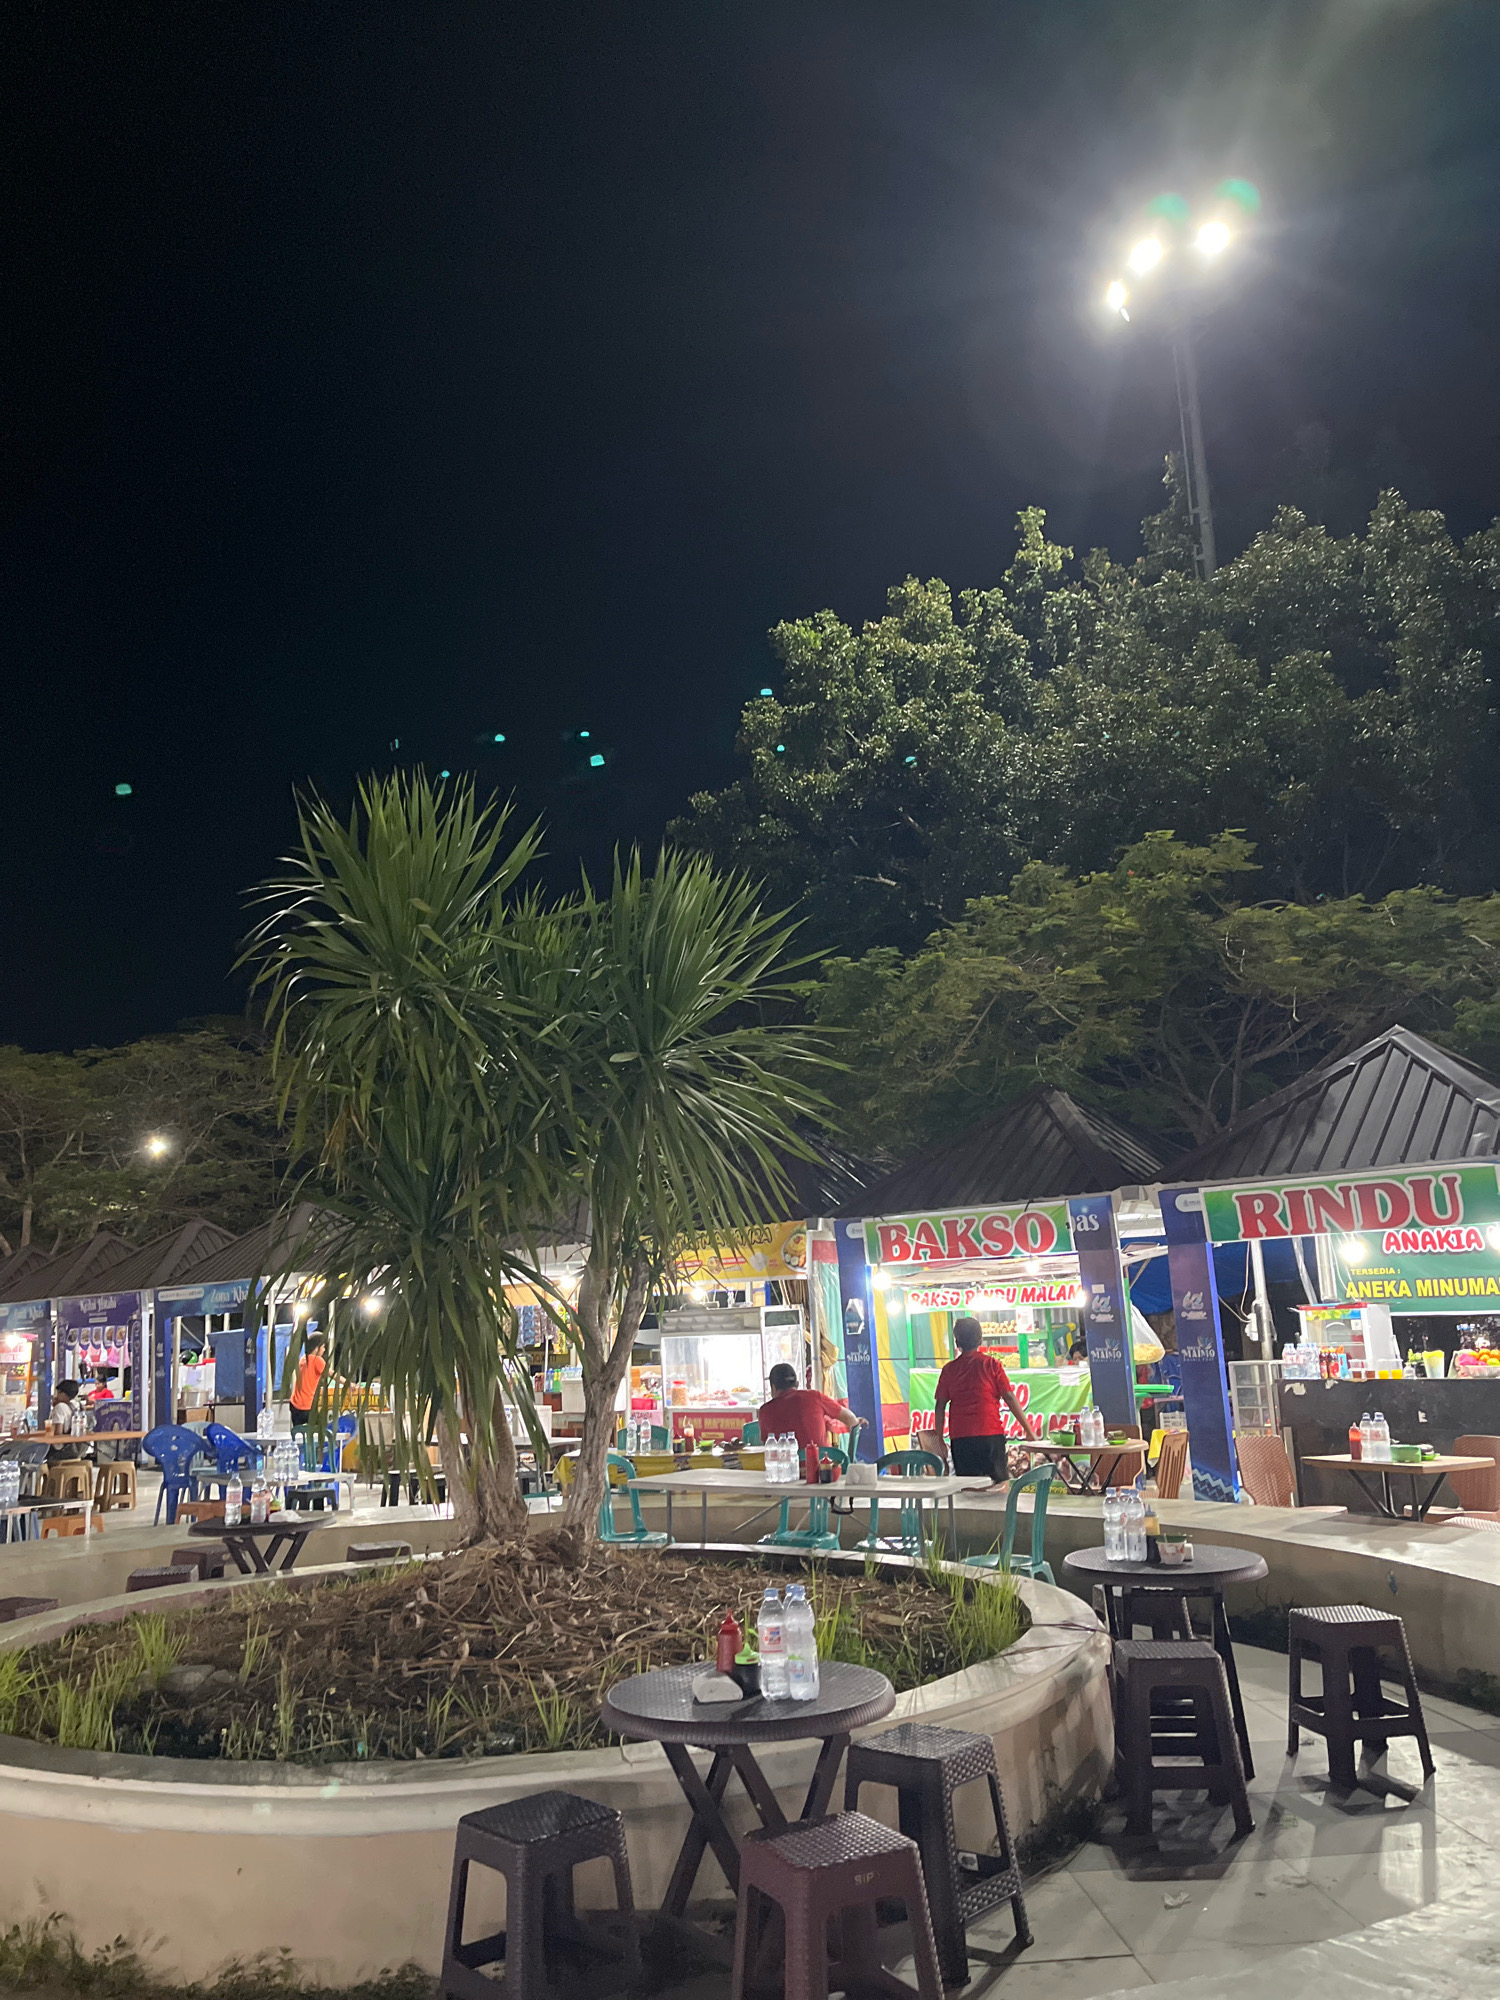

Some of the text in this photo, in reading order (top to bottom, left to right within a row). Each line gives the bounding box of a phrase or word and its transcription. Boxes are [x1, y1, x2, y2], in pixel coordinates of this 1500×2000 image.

[1235, 1176, 1460, 1239] RINDU
[878, 1211, 1055, 1263] BAKSO
[1383, 1227, 1484, 1252] ANAKIA
[1350, 1268, 1395, 1276] TERSEDIA
[965, 1288, 1016, 1305] RNDU
[1345, 1277, 1500, 1298] ANEKA MINUMA
